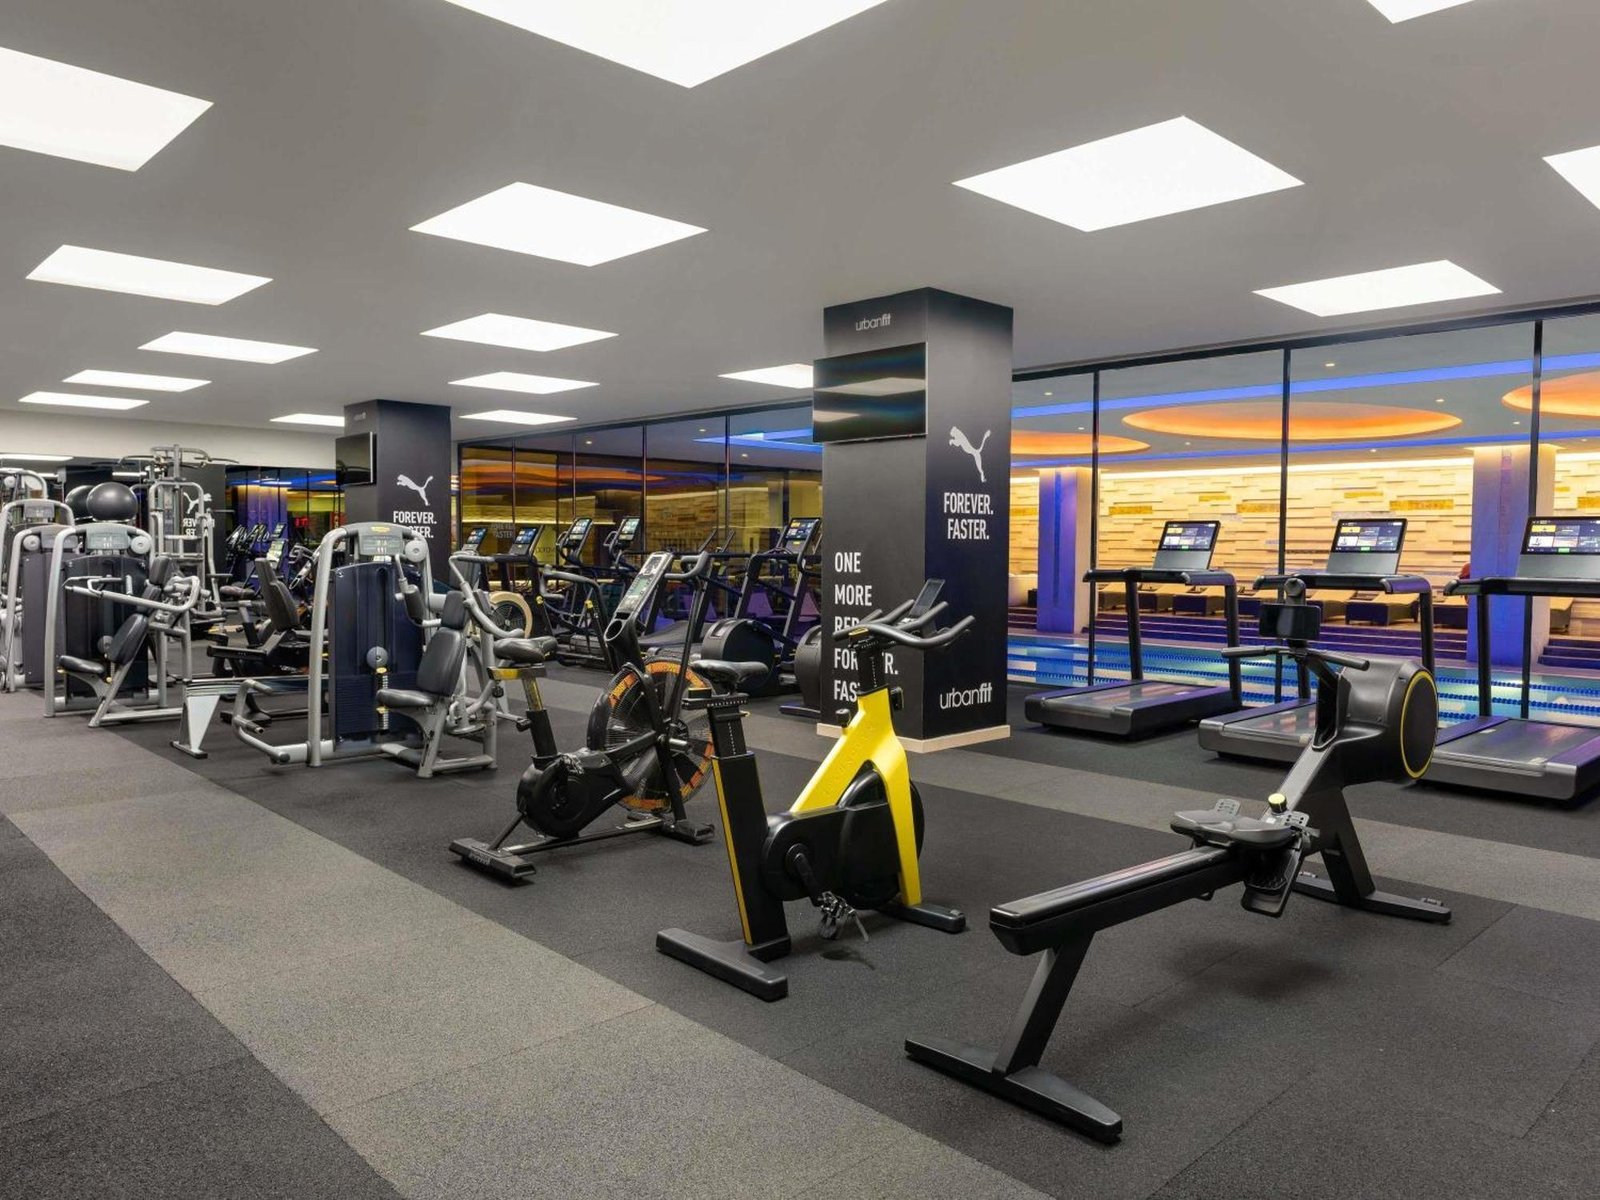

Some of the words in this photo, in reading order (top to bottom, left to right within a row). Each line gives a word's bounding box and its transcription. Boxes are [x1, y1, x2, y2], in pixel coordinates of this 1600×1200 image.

[856, 313, 891, 331] urbanfit
[944, 492, 994, 515] FOREVER.
[393, 510, 437, 525] FOREVER.
[948, 518, 990, 540] FASTER.
[834, 552, 861, 573] ONE
[834, 584, 872, 606] MORE
[834, 648, 899, 675] FORR.
[940, 682, 992, 709] urbanfit
